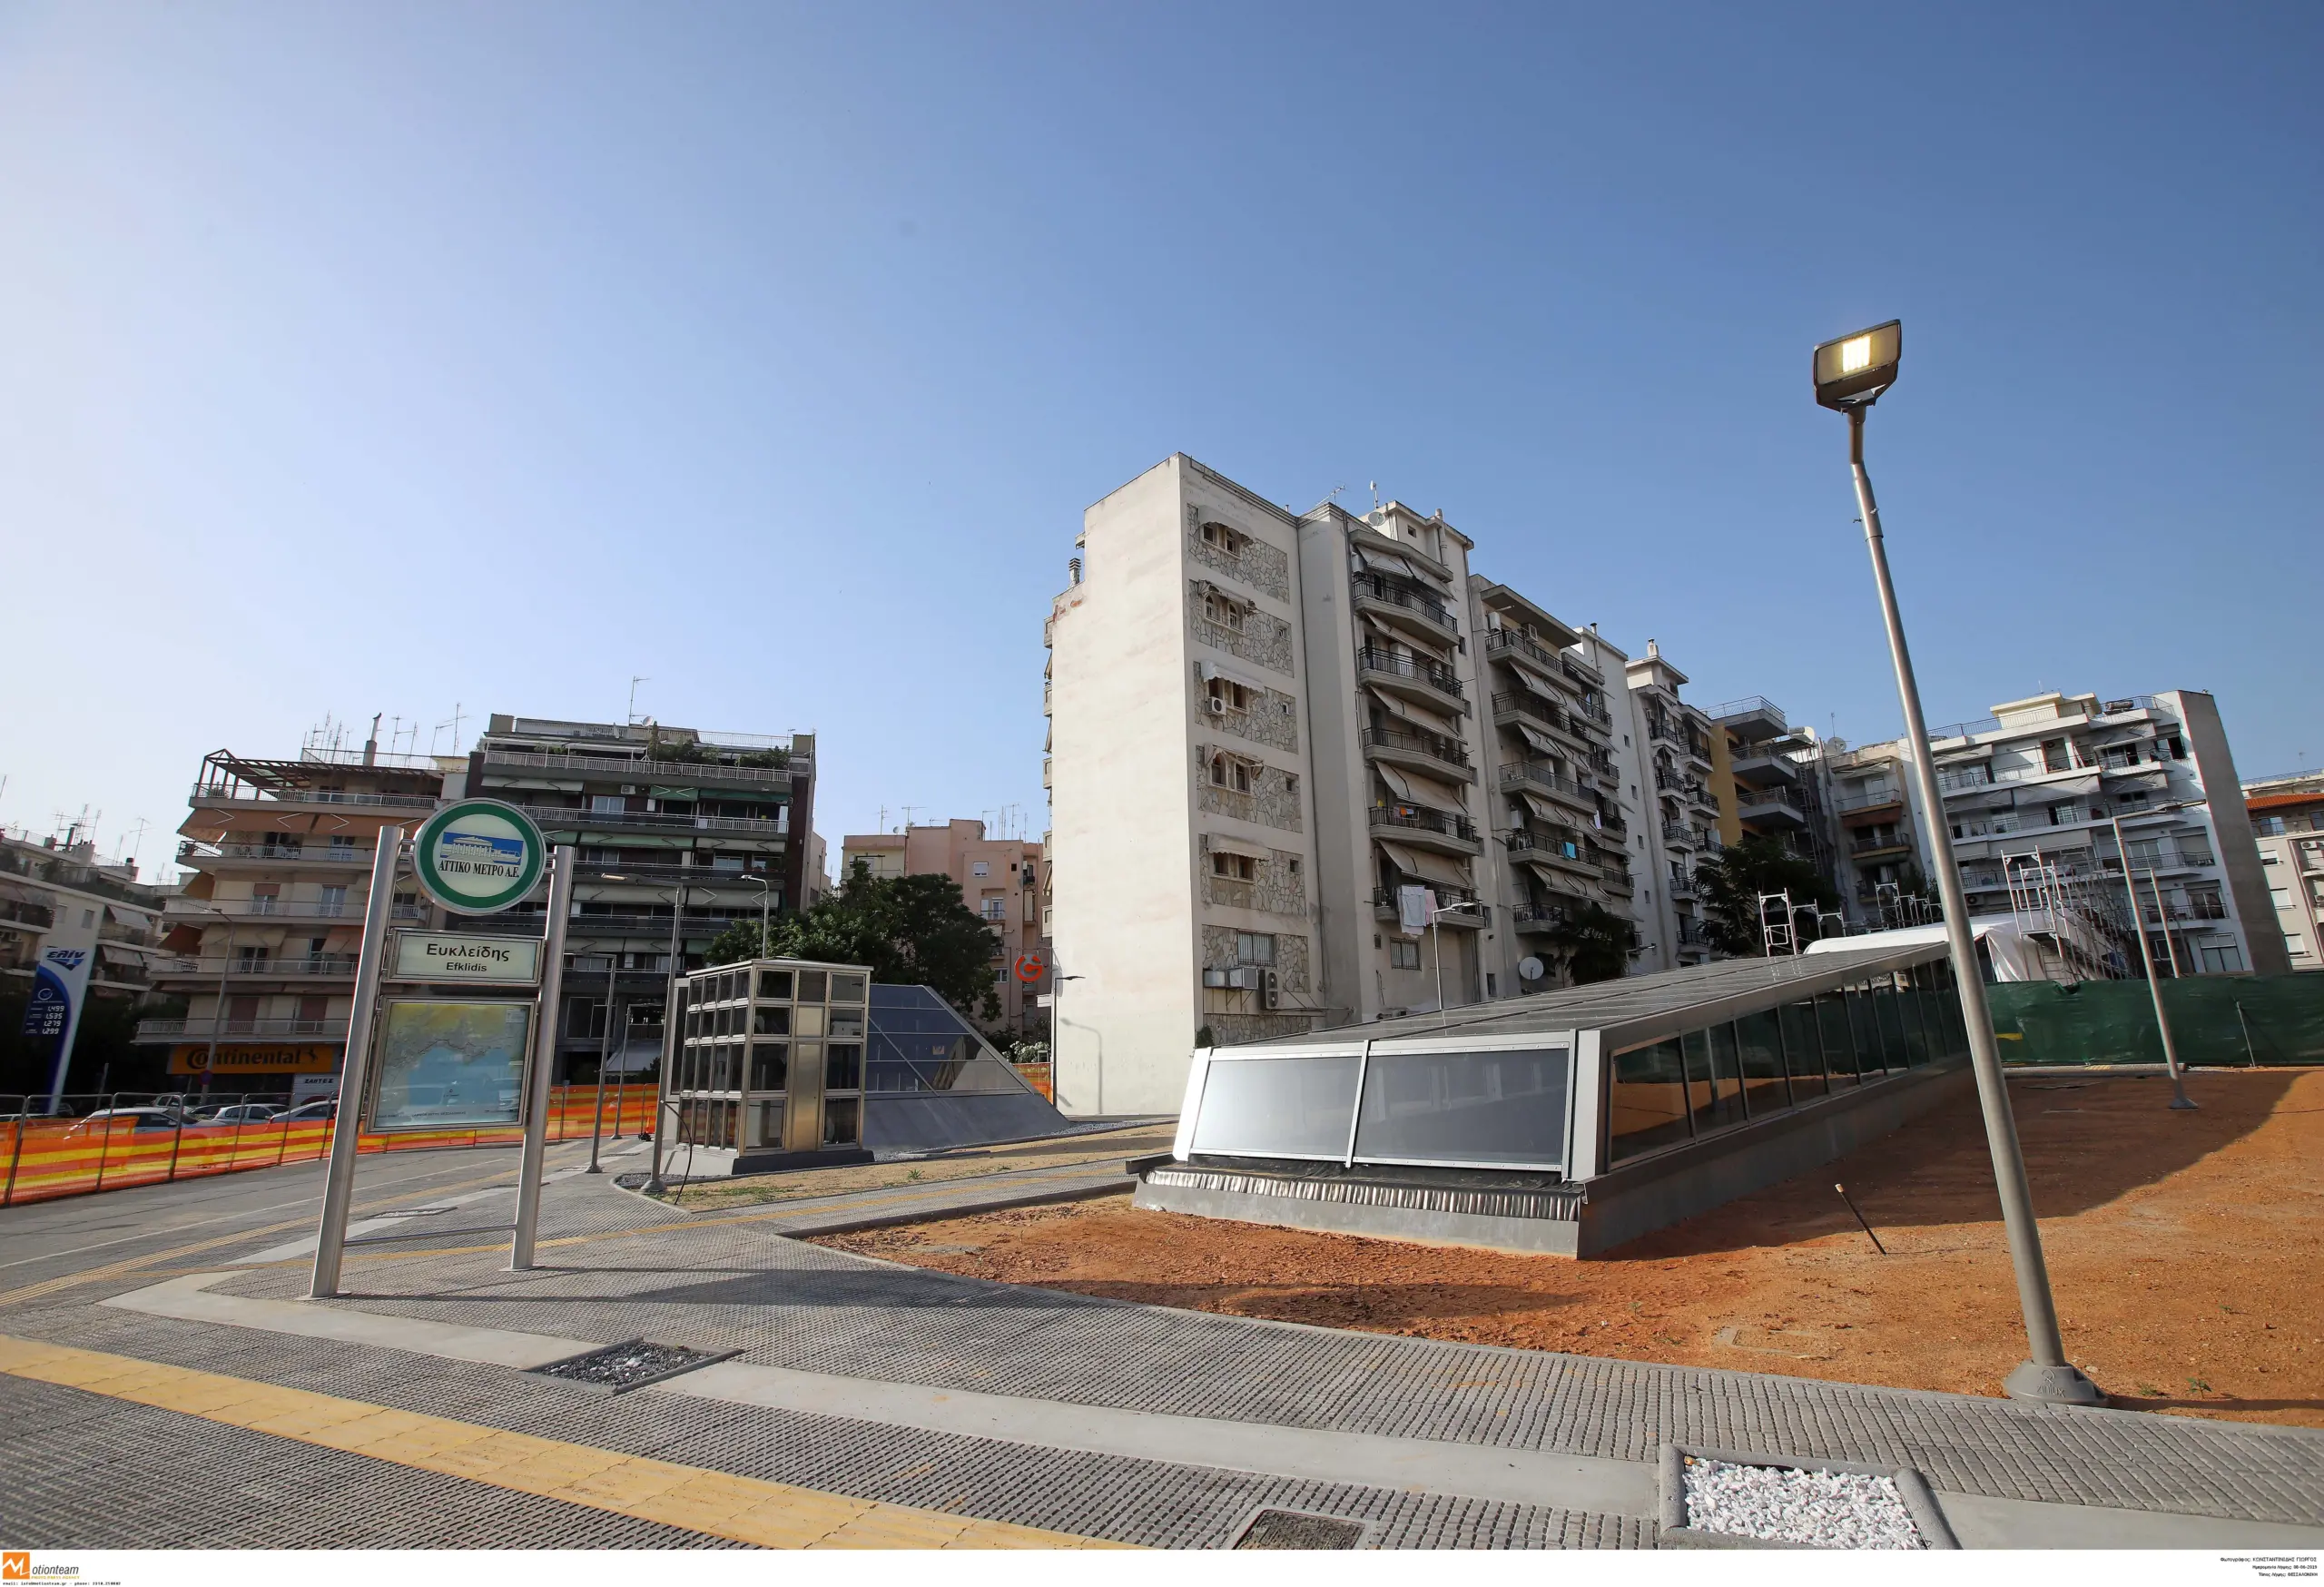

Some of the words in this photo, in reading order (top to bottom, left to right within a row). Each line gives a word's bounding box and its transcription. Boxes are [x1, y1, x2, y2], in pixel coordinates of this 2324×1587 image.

[438, 859, 471, 874] ΑΤΤΙΚΟ
[473, 863, 506, 877] ΜΕΤΡΟ
[505, 866, 520, 879] Α.Ε.
[426, 942, 510, 962] Ευκλείδης
[446, 961, 487, 973] Efklidis
[186, 1048, 301, 1070] Continental
